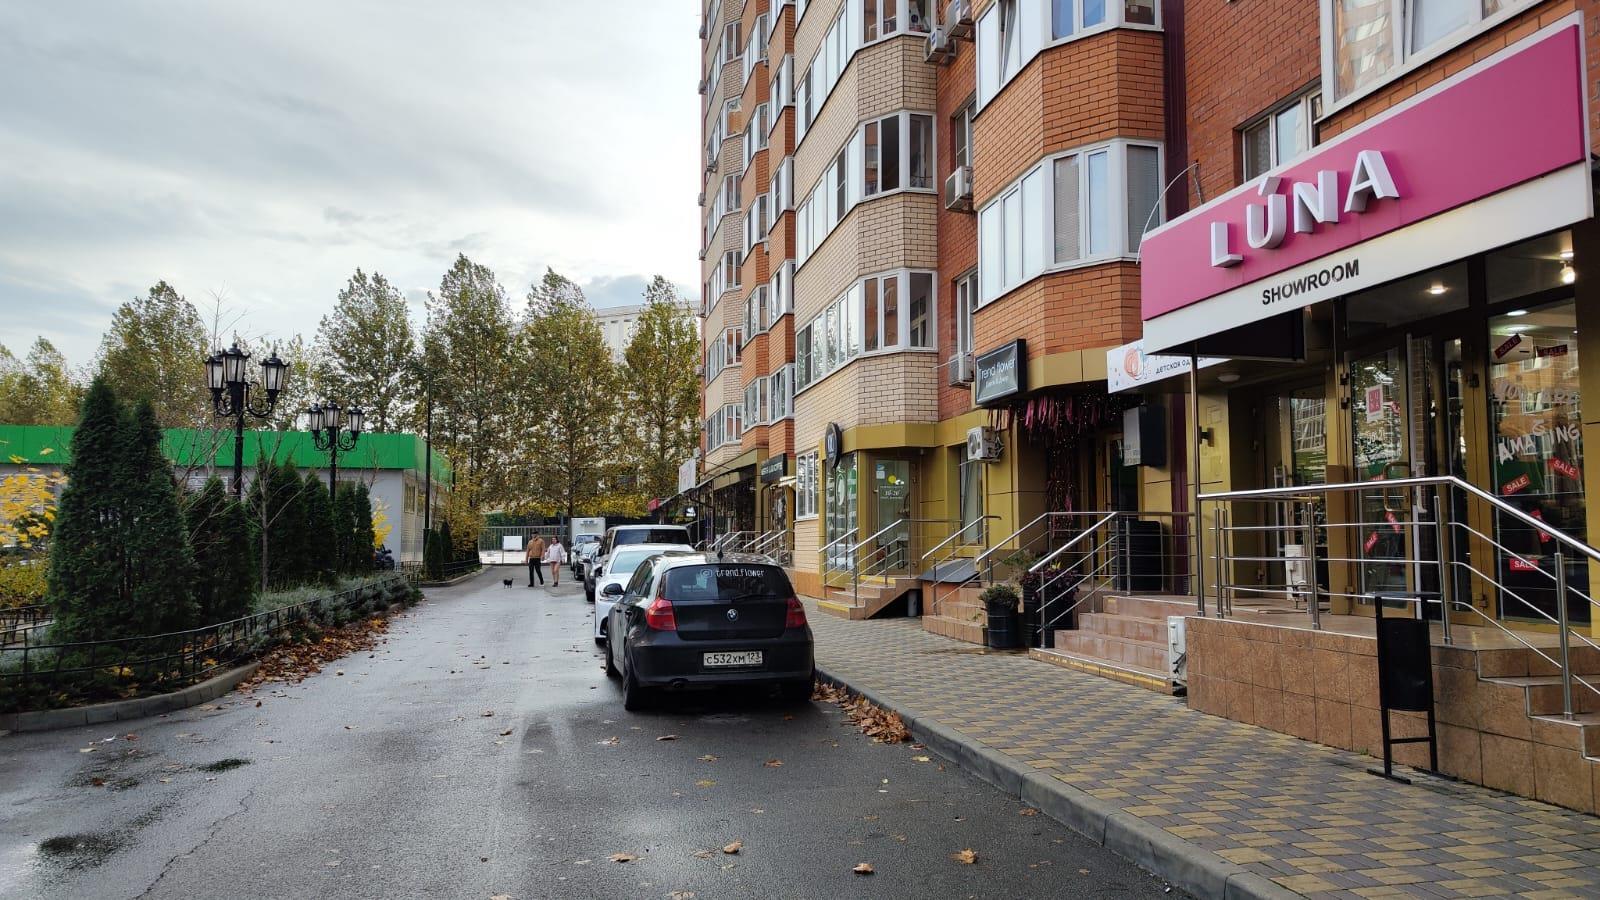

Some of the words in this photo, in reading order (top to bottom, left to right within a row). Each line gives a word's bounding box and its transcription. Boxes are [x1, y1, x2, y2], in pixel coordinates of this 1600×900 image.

[1262, 258, 1359, 305] SHOWROOM
[1553, 459, 1577, 476] SALE
[1506, 477, 1527, 492] SALE
